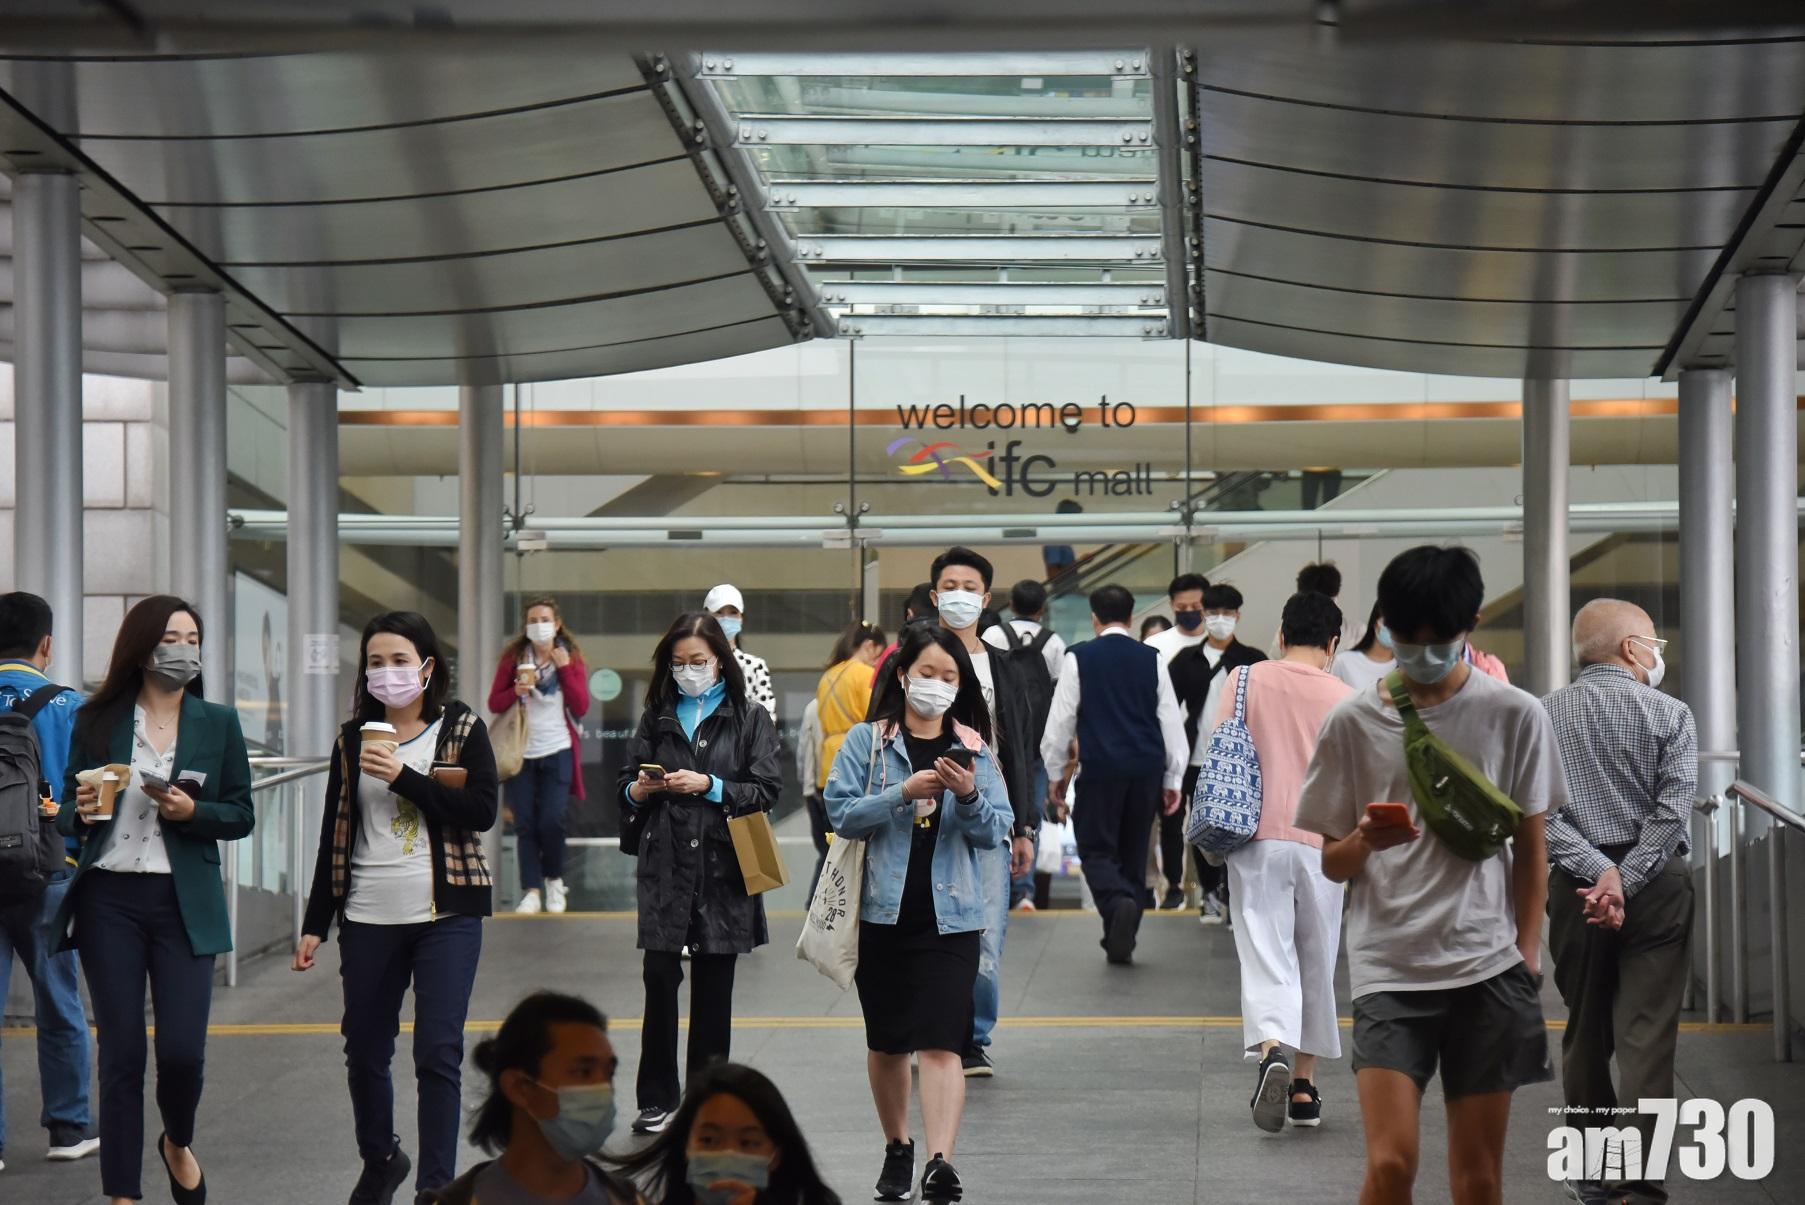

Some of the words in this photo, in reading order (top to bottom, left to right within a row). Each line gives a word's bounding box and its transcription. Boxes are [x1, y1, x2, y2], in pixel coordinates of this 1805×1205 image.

[897, 394, 1082, 430] welcome
[1097, 394, 1136, 428] to
[985, 440, 1056, 497] ifc
[1073, 462, 1153, 496] mall
